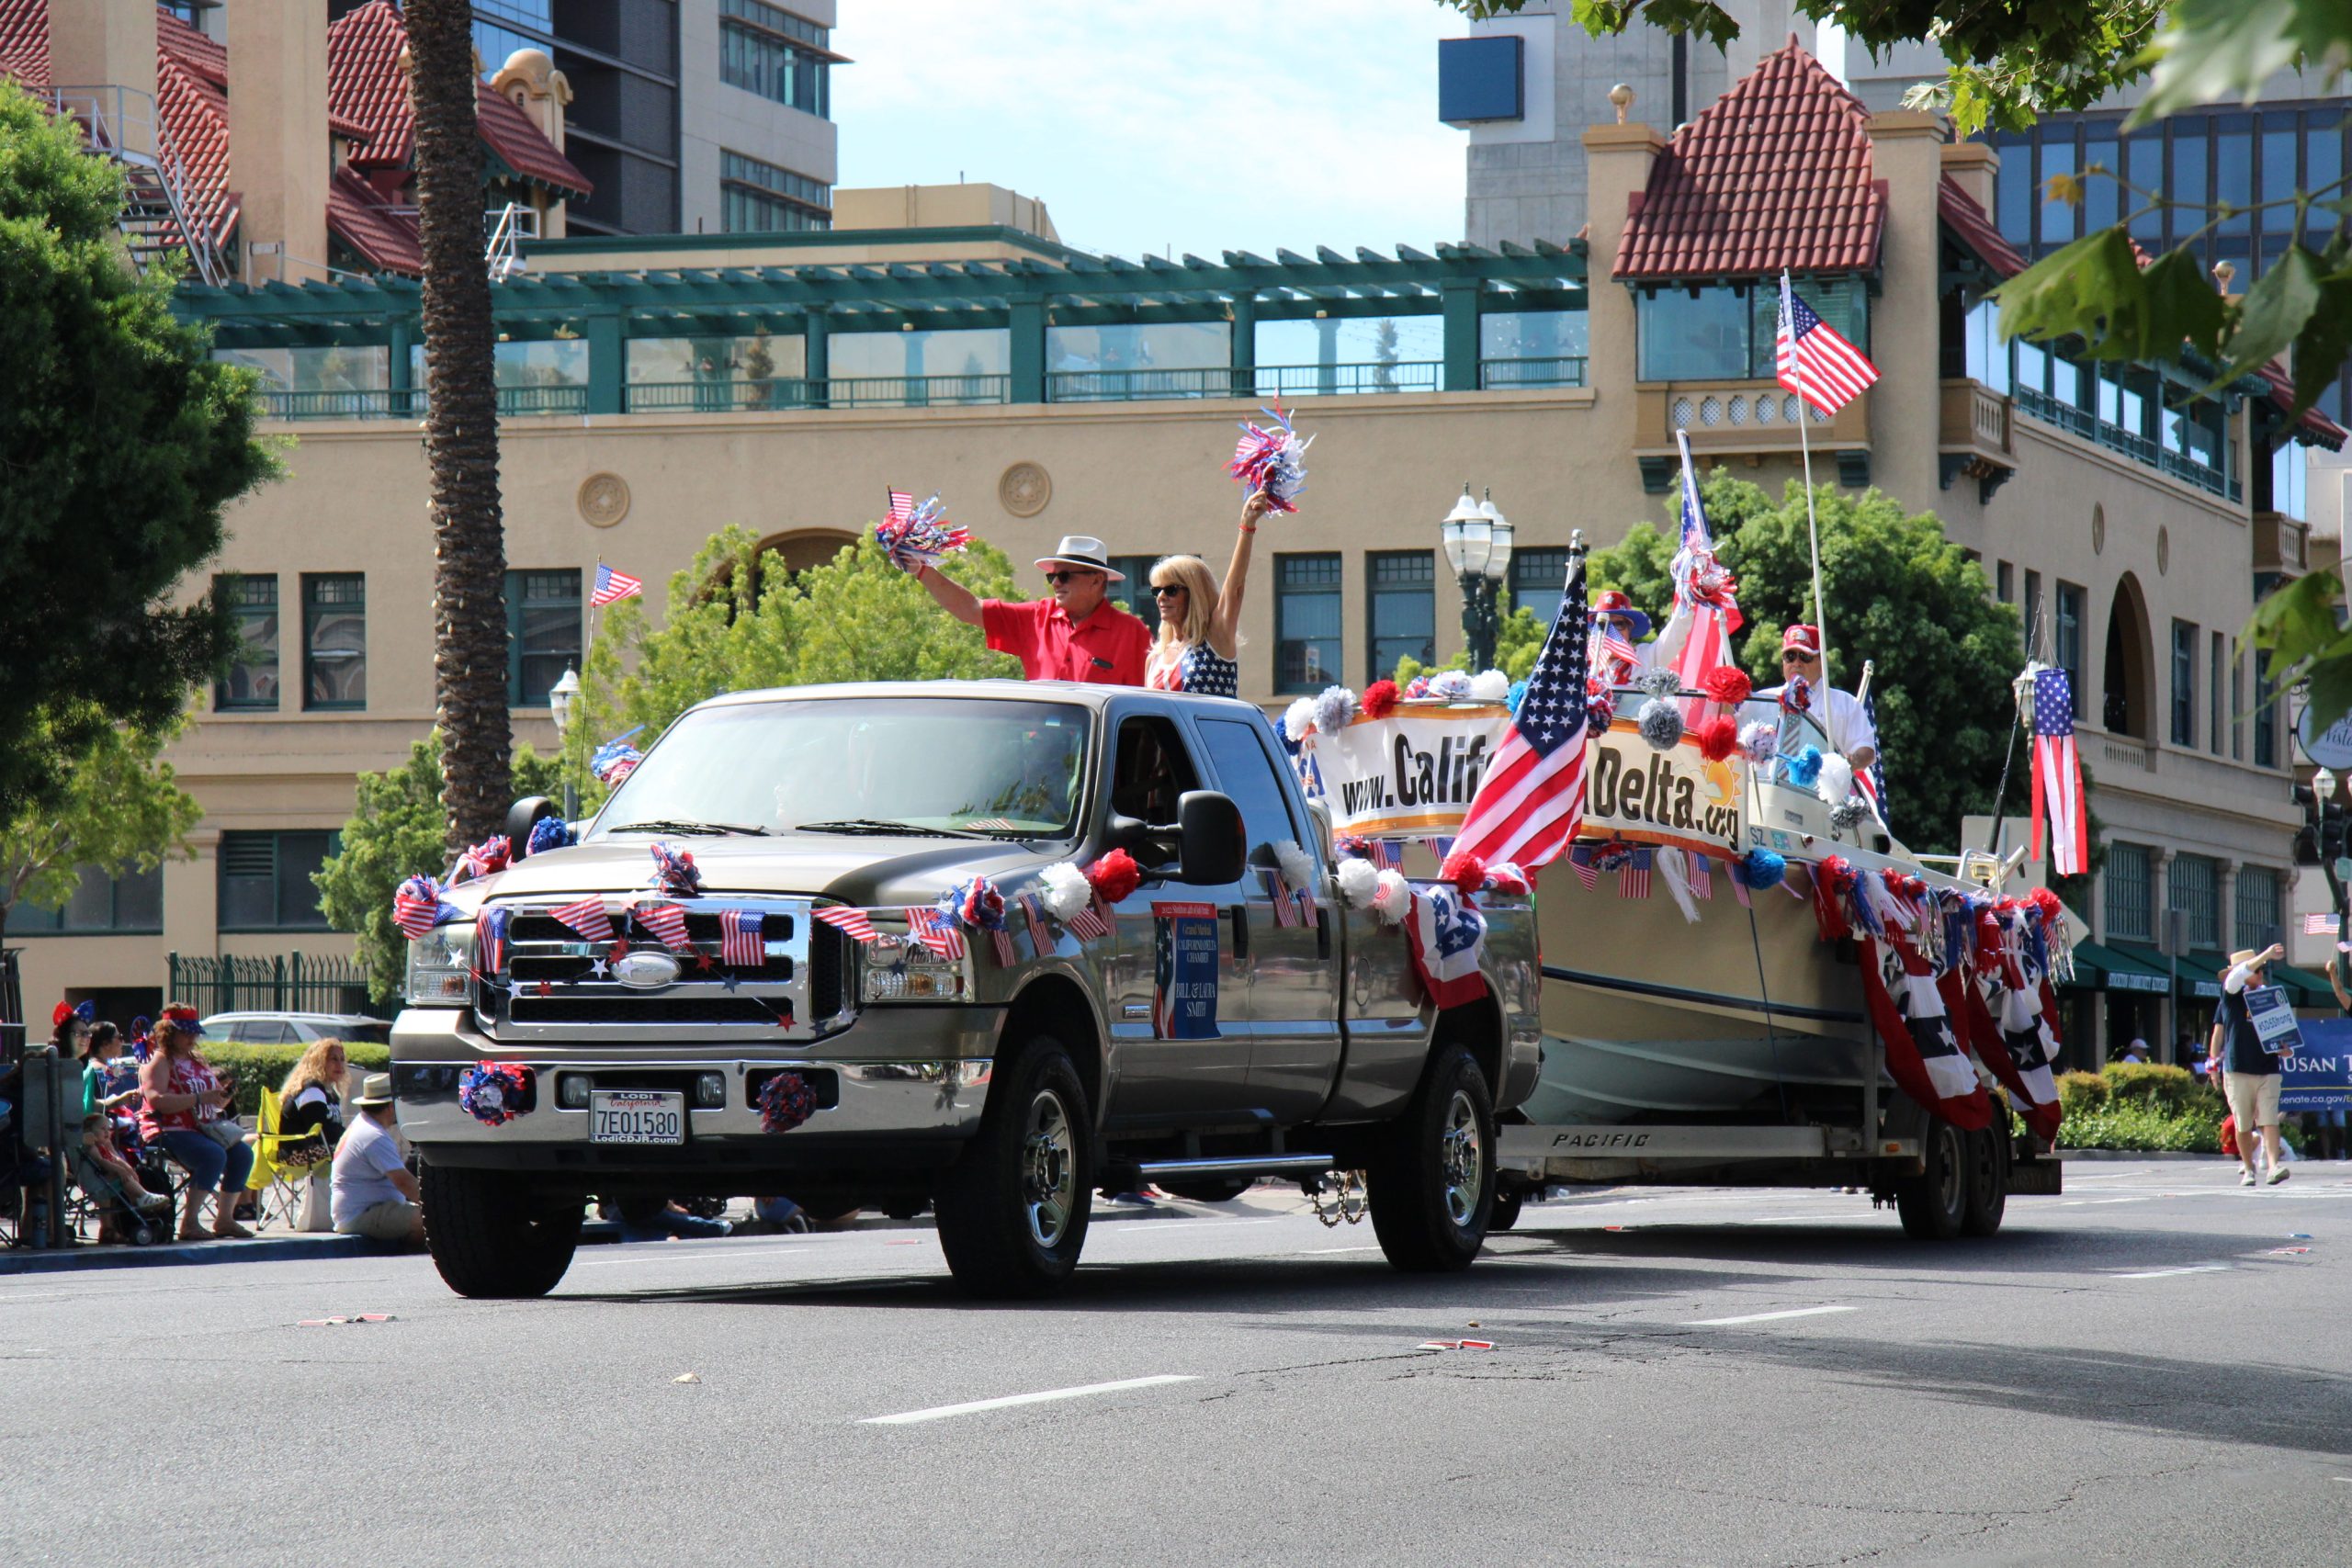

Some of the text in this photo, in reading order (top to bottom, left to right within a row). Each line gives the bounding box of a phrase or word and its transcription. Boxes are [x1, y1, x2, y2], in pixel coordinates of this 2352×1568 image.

[1749, 827, 1767, 847] SZ
[1176, 982, 1216, 998] BILL & LAURA
[1186, 1001, 1206, 1018] SMITH
[2278, 1056, 2336, 1073] USAN
[611, 1099, 666, 1110] California
[2279, 1095, 2352, 1105] senate.ca.gov/E
[597, 1111, 677, 1135] 7E01580
[1553, 1134, 1650, 1147] PACIFIC
